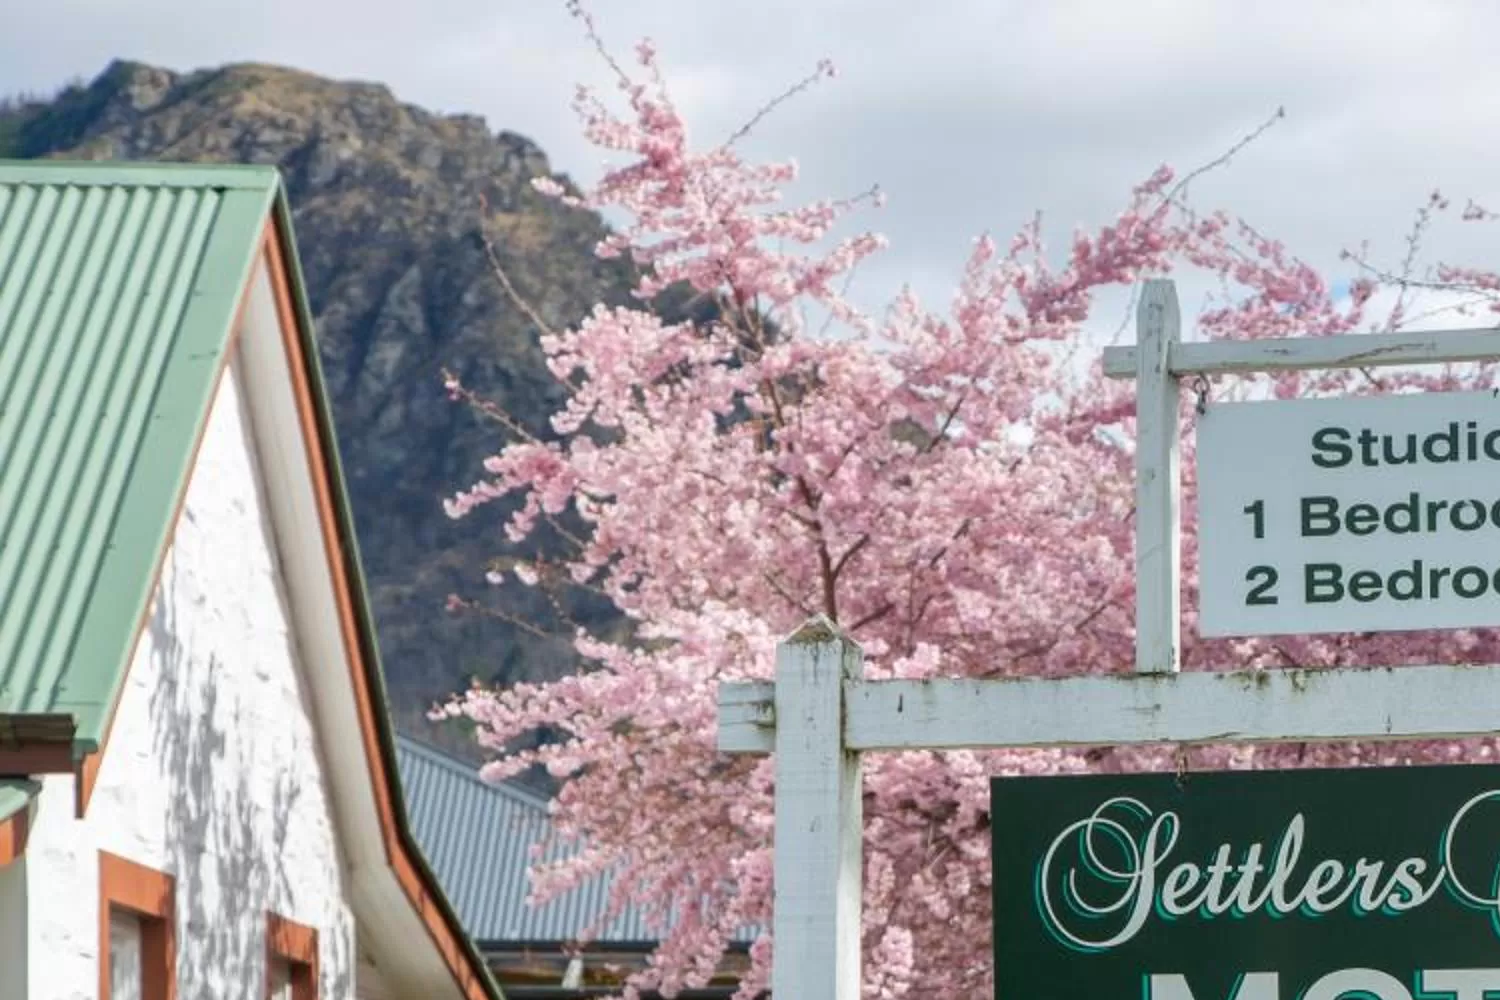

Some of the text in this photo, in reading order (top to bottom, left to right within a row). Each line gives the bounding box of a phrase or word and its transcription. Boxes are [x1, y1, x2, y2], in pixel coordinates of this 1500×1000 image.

[1243, 499, 1266, 539] 1
[1244, 565, 1279, 605] 2
[1036, 796, 1446, 953] Settlers
